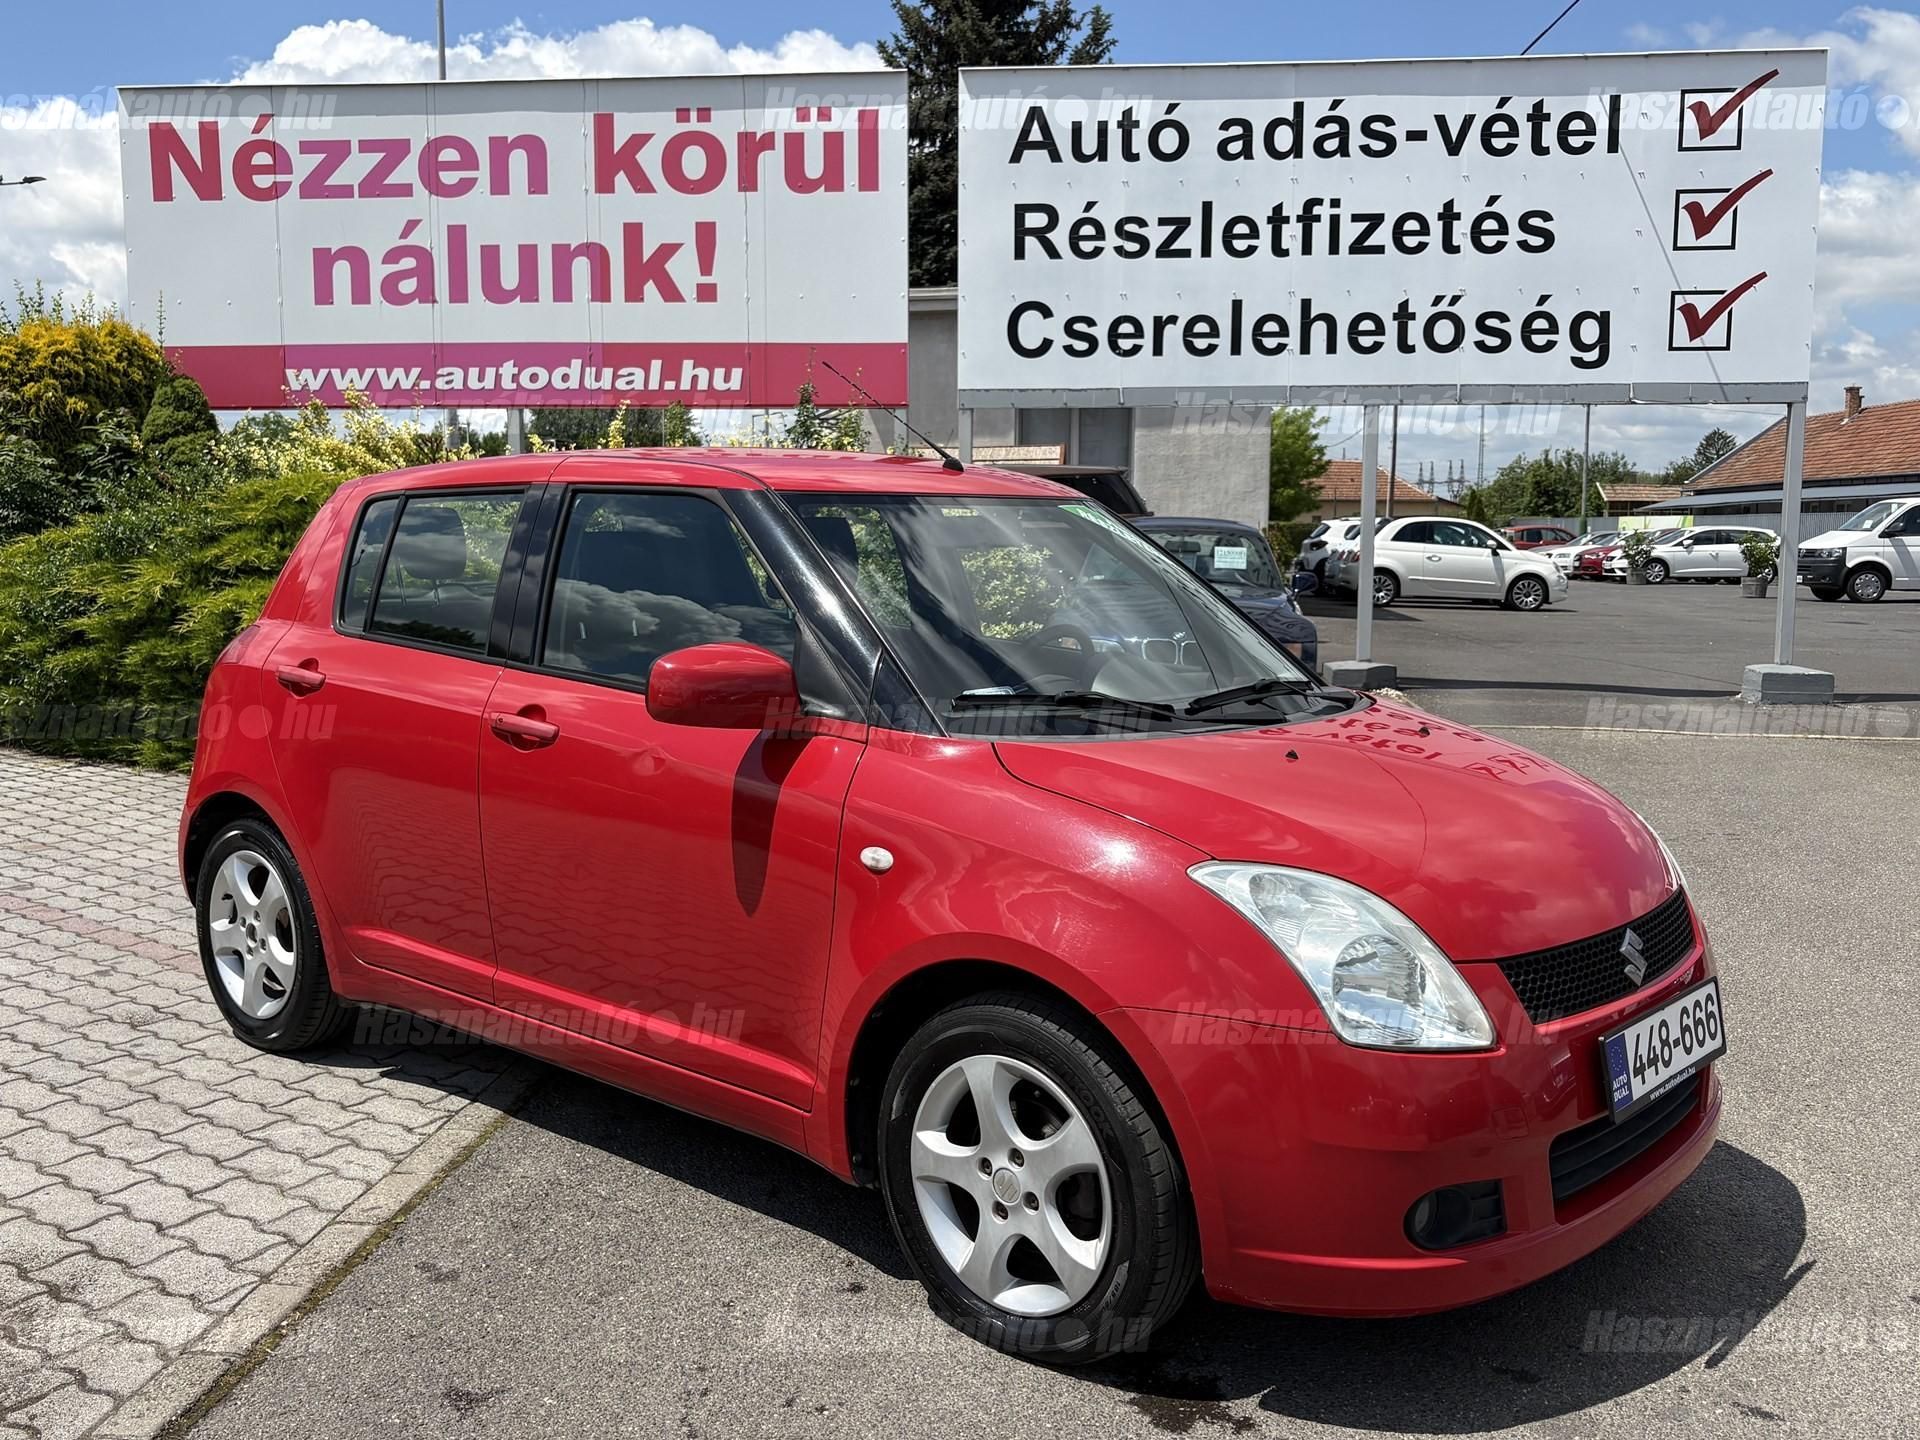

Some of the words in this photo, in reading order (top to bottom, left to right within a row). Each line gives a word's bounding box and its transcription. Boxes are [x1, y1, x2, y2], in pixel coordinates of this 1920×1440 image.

[149, 114, 549, 202] Nézzen
[593, 106, 881, 195] körül
[1008, 100, 1191, 165] Autó
[1216, 94, 1622, 161] adás-vétel
[311, 219, 719, 306] nálunk!
[1012, 194, 1556, 261] Részletfizetés
[1006, 293, 1612, 370] Cserelehetőség
[285, 357, 744, 394] www.autodual.hu
[1632, 992, 1718, 1086] 448-666
[1612, 1071, 1629, 1092] AUTÓ
[1613, 1085, 1630, 1103] DUAL
